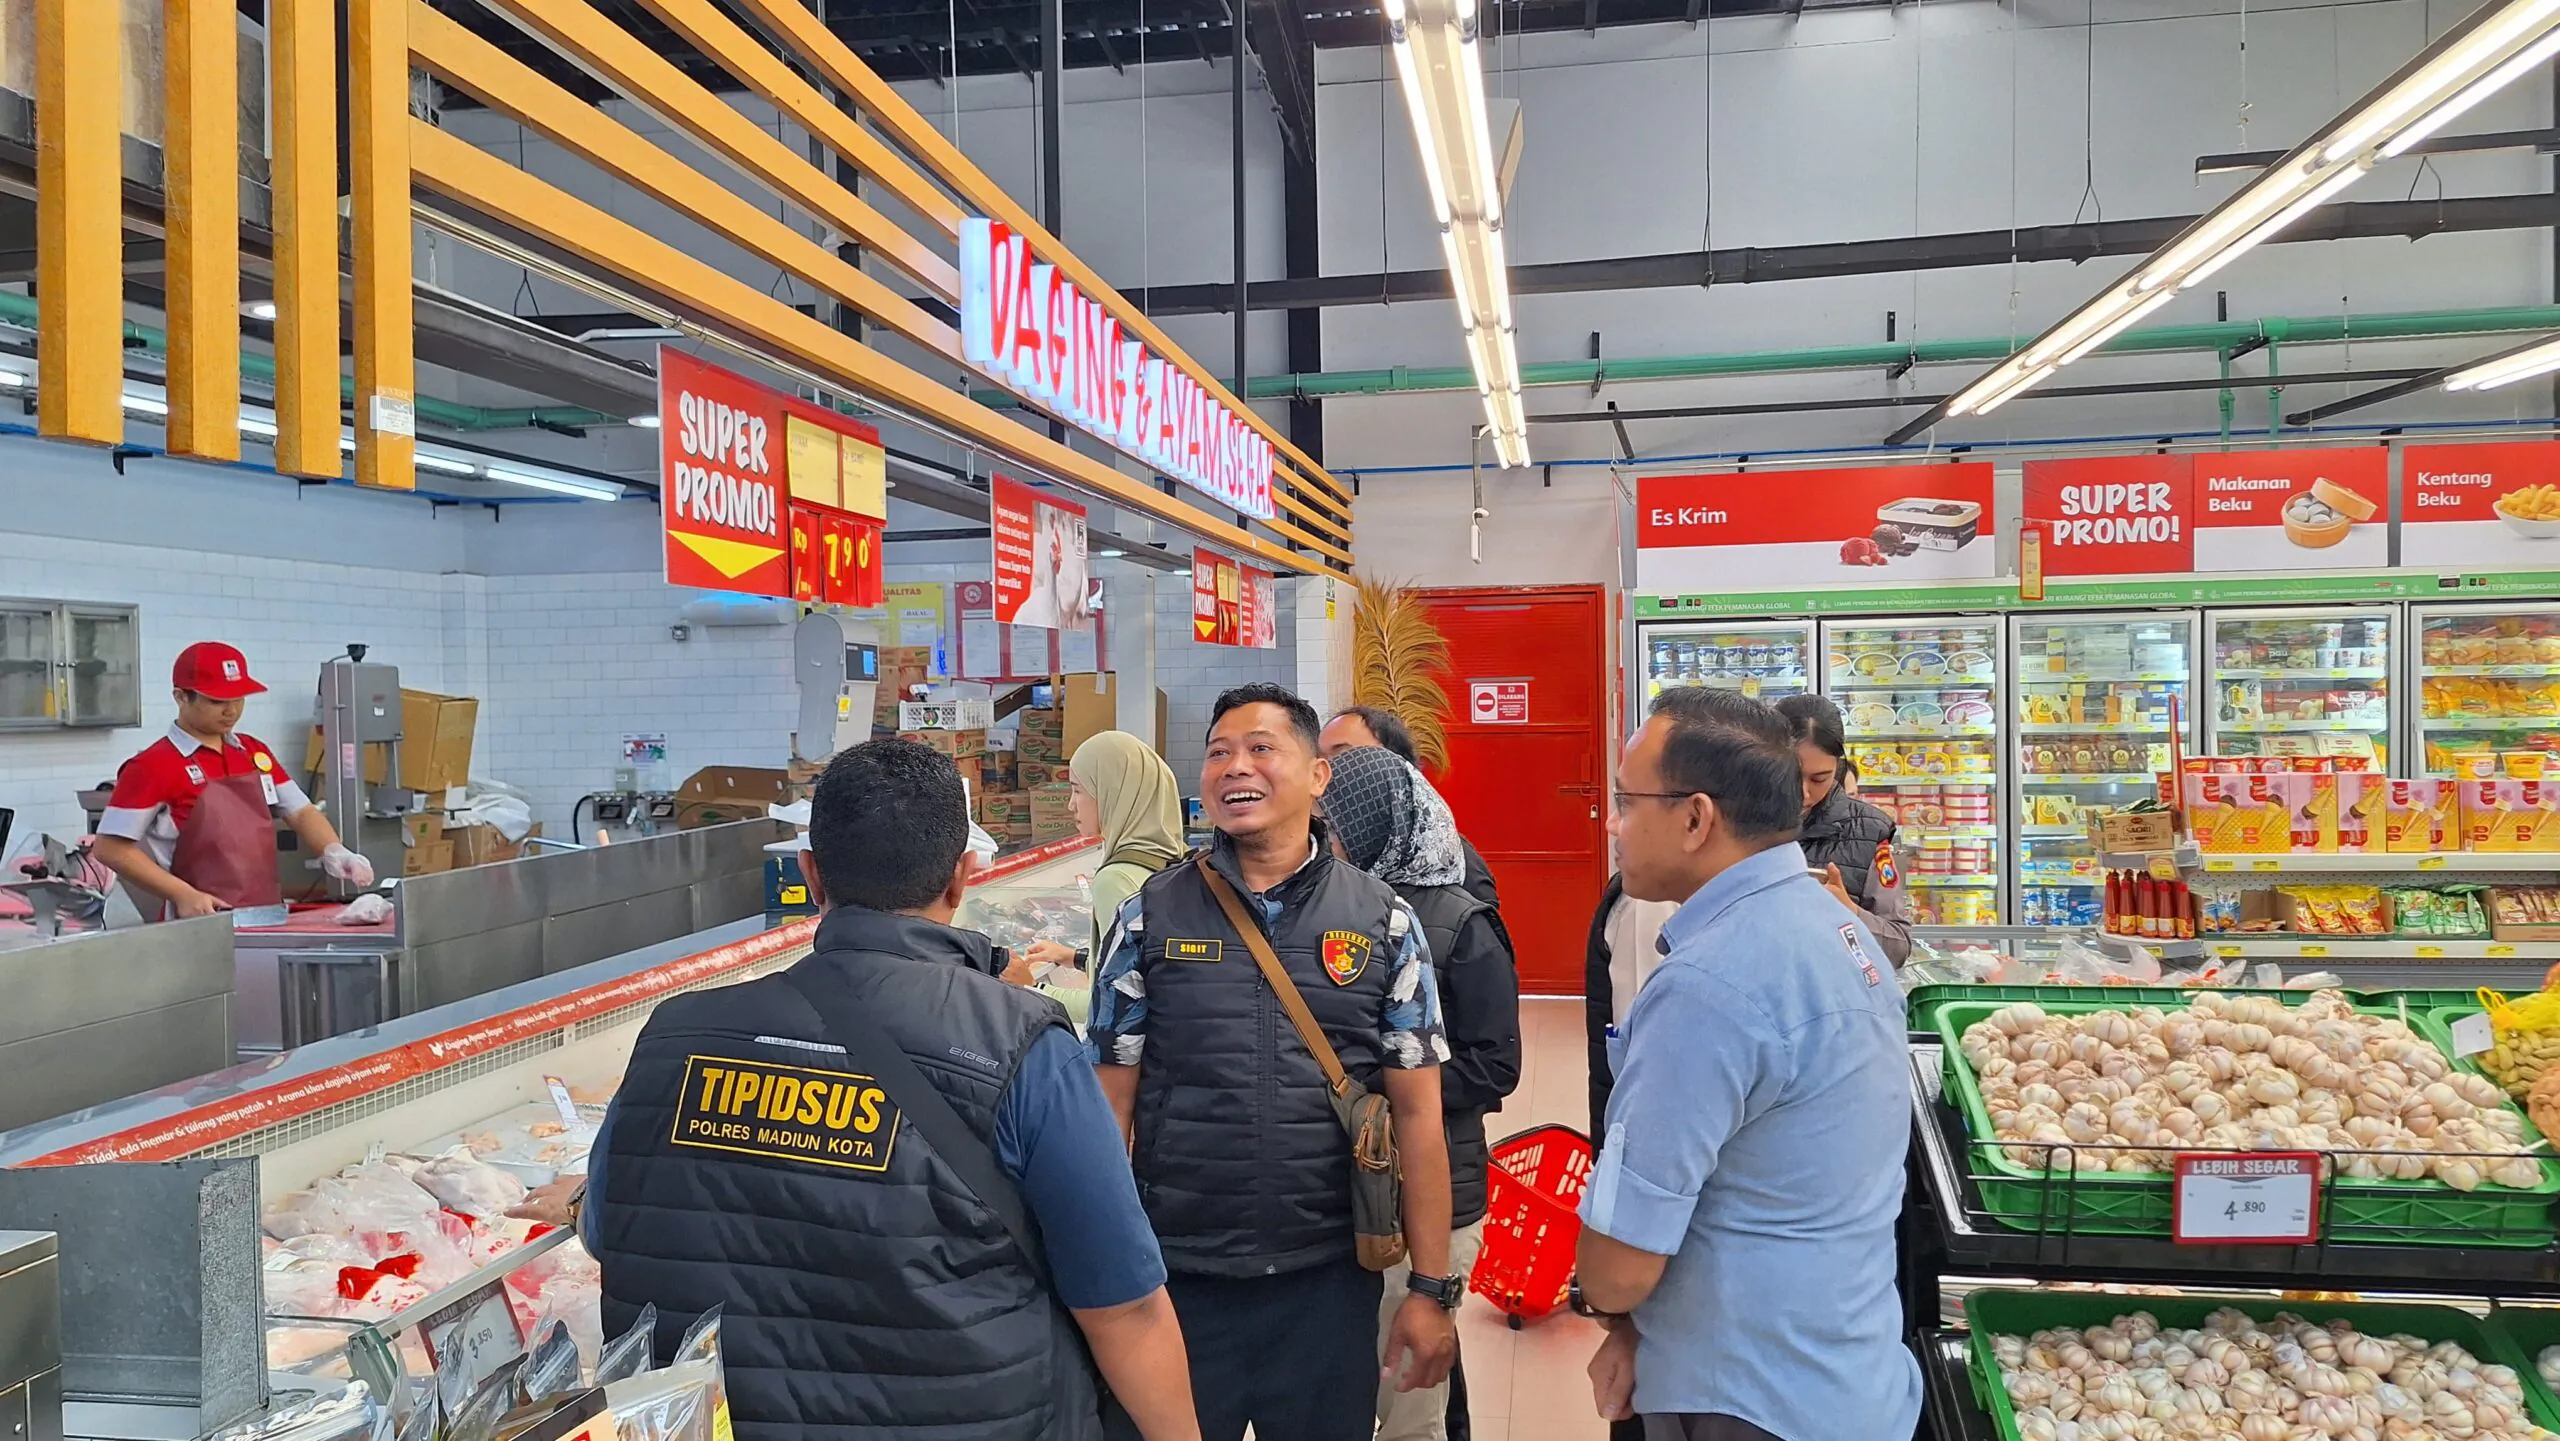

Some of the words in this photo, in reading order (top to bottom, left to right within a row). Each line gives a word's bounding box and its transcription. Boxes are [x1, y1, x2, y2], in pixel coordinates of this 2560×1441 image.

[987, 221, 1127, 434] DAGING
[1135, 341, 1153, 446] &
[1158, 359, 1223, 486] AYAM
[679, 390, 770, 475] SUPER
[2208, 476, 2291, 493] Makanan
[2416, 470, 2492, 489] Kentang
[674, 461, 777, 537] PROMO!
[2060, 481, 2172, 516] SUPER
[2208, 497, 2252, 513] Beku
[2416, 491, 2461, 507] Beku
[1651, 507, 1674, 527] Es
[1678, 506, 1728, 526] Krim
[793, 528, 808, 554] Rp
[2053, 515, 2181, 546] PROMO!
[1196, 562, 1214, 591] SUPER
[883, 587, 922, 597] UALITAS
[1195, 592, 1216, 617] PROMO!
[2150, 591, 2177, 600] GLOBAL
[1766, 602, 1791, 610] GLOBAL
[949, 1046, 1001, 1069] EIGER
[87, 1148, 119, 1164] Tidak
[119, 1142, 140, 1156] ada
[139, 1131, 175, 1150] memar
[174, 1128, 186, 1138] &
[185, 1118, 217, 1135] tulang
[215, 1110, 240, 1126] yang
[238, 1101, 266, 1118] patah
[304, 1082, 326, 1095] khas
[324, 1074, 352, 1089] daging
[351, 1067, 373, 1081] ayam
[371, 1061, 393, 1076] segar
[699, 1067, 886, 1134] TIPIDSUS
[688, 1119, 752, 1142] POLRES
[756, 1127, 822, 1154] MADIUN
[827, 1136, 876, 1160] KOTA
[2192, 1160, 2240, 1175] LEBIH
[2243, 1159, 2300, 1174] SEGAR
